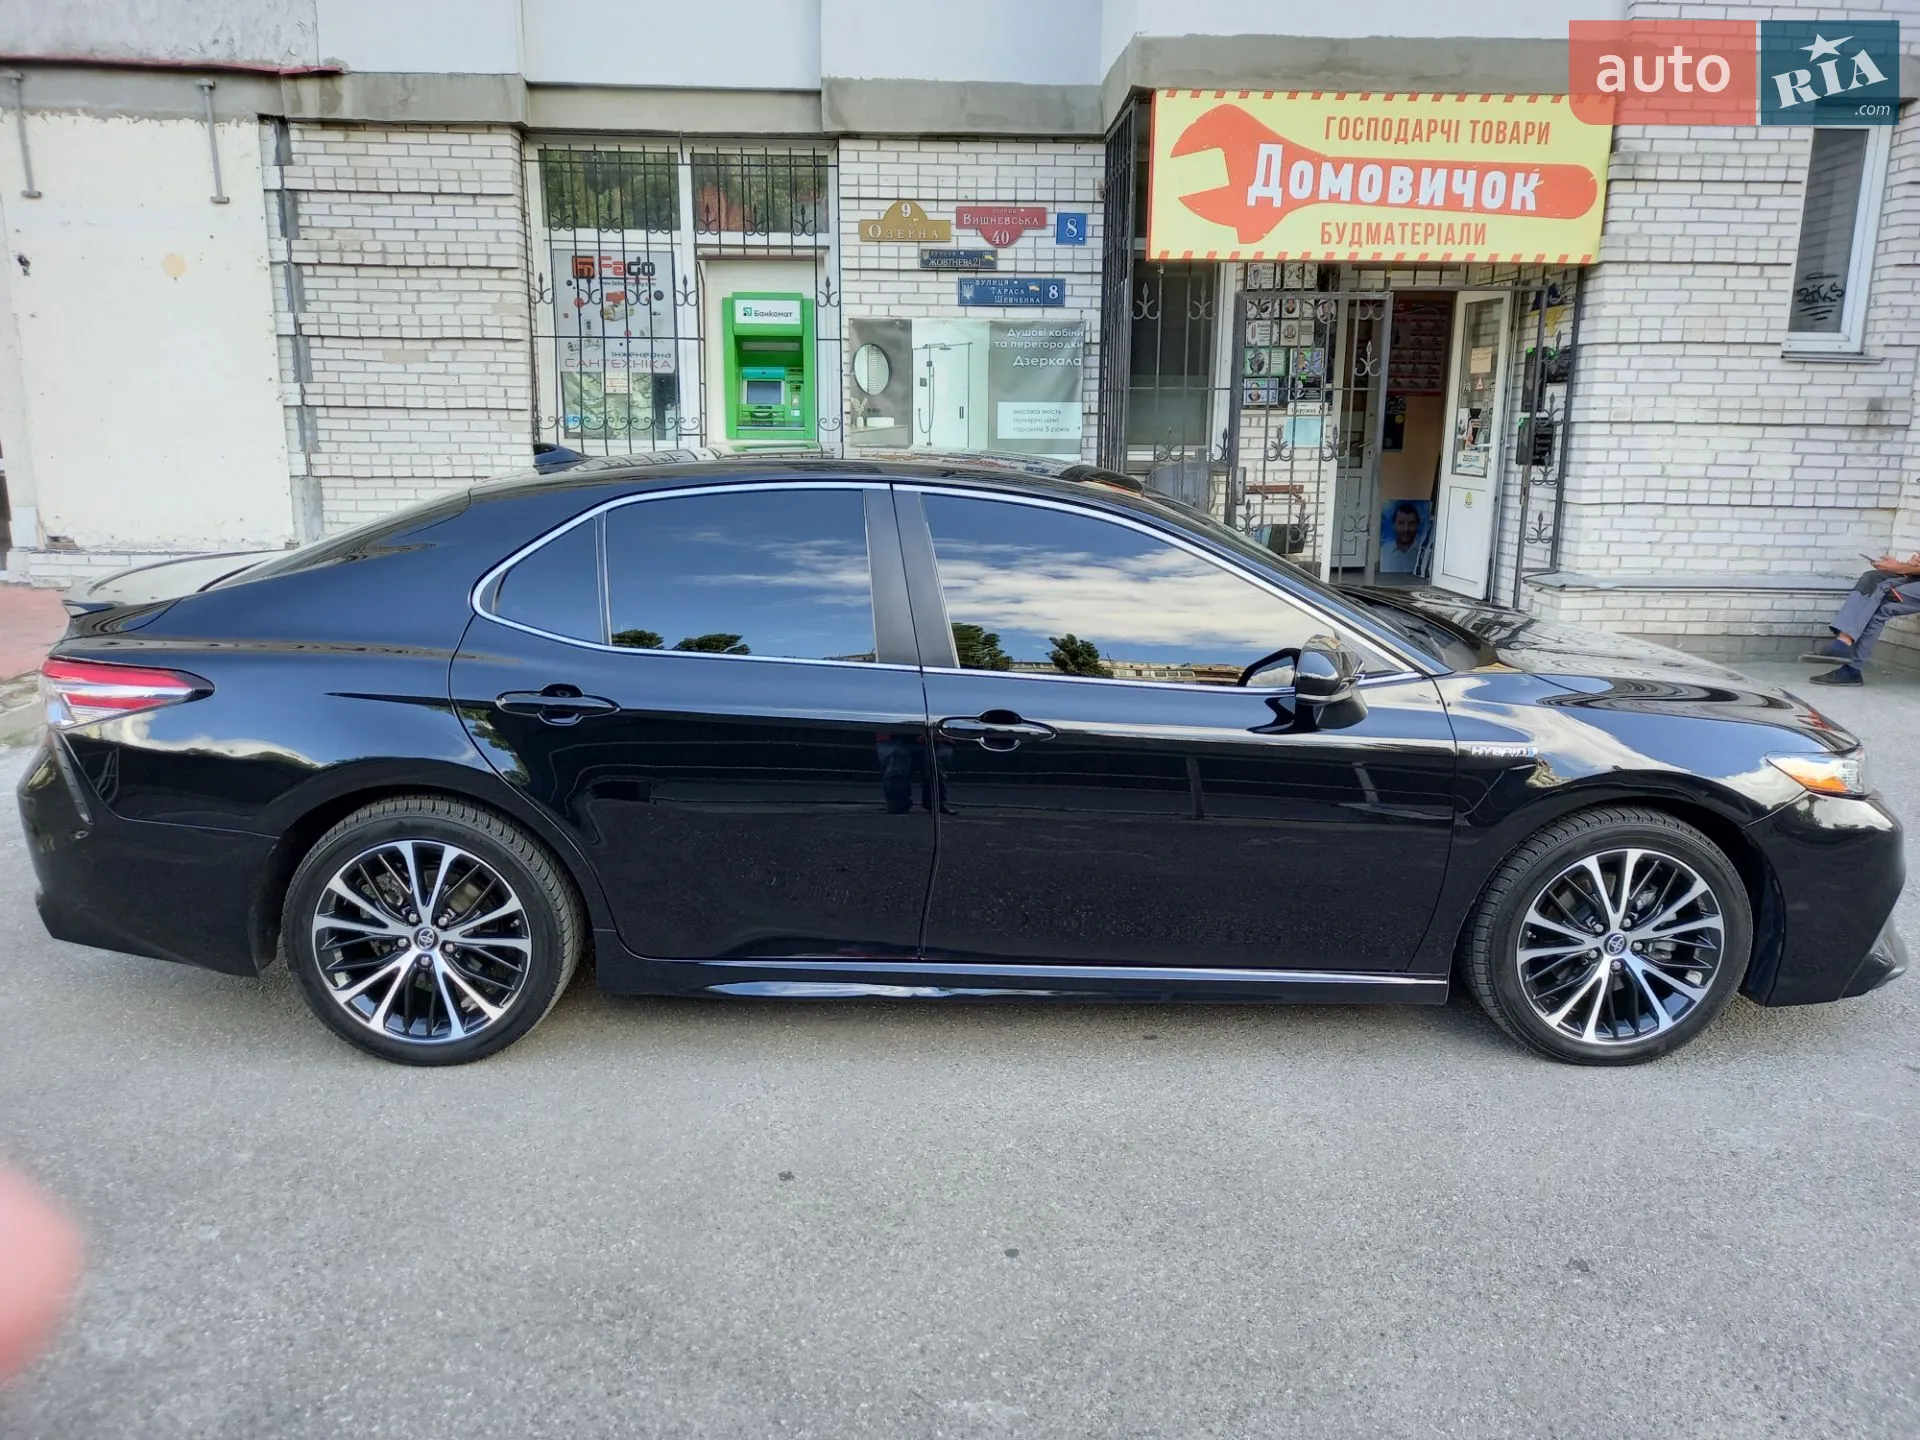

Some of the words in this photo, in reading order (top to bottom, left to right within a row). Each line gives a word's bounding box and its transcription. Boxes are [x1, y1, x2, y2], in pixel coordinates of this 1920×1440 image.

[1324, 115, 1461, 145] ГОСПОДАРЧІ
[1469, 119, 1551, 146] ТОВАРИ
[901, 203, 912, 218] 9
[1065, 218, 1078, 238] 8
[1320, 221, 1487, 247] БУДМАТЕРІАЛИ
[991, 230, 1010, 244] 40
[599, 255, 656, 276] Fado
[1048, 284, 1059, 299] 8
[754, 309, 793, 318] Банкомат
[1007, 328, 1047, 338] Душові
[1049, 328, 1084, 337] кабіни
[993, 341, 1007, 349] та
[1010, 340, 1083, 350] перегородки
[565, 359, 672, 369] САНТЕХНІКА
[1013, 355, 1082, 368] Дзеркала
[1471, 746, 1529, 758] HYBRID
